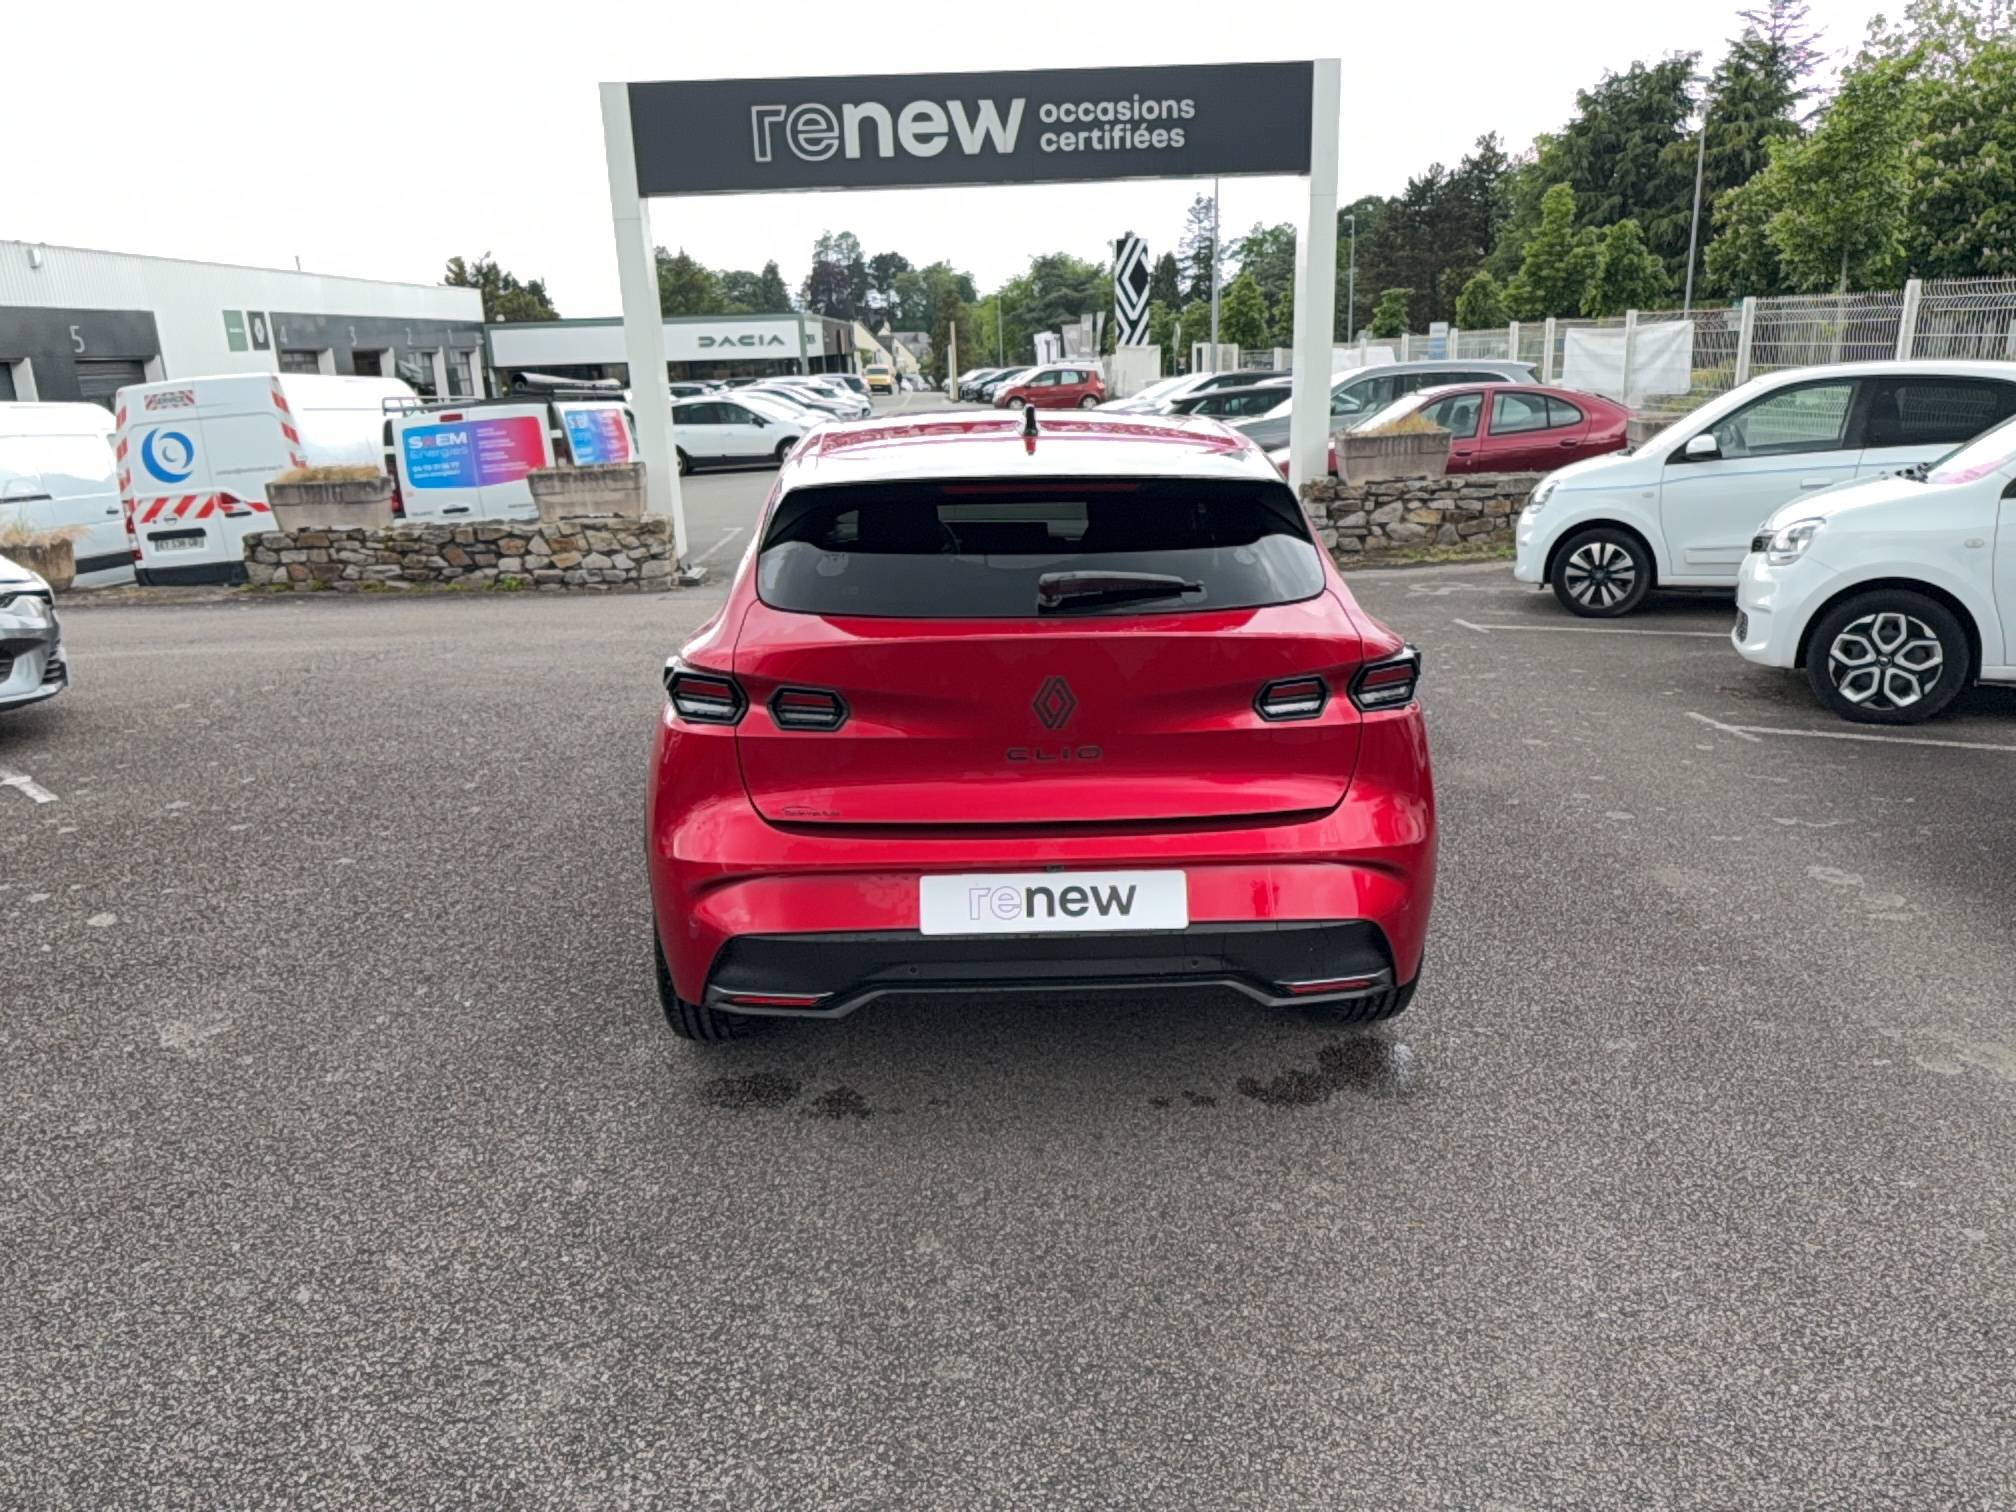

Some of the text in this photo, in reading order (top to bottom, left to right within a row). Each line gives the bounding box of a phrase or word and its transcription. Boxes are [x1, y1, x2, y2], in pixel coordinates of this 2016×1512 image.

[1039, 93, 1196, 123] occasions
[751, 98, 1026, 162] renew
[1040, 122, 1186, 152] certifiées
[69, 325, 86, 353] 5
[698, 334, 785, 348] DACIA
[1007, 745, 1102, 761] CLIO
[968, 884, 1137, 921] renew
